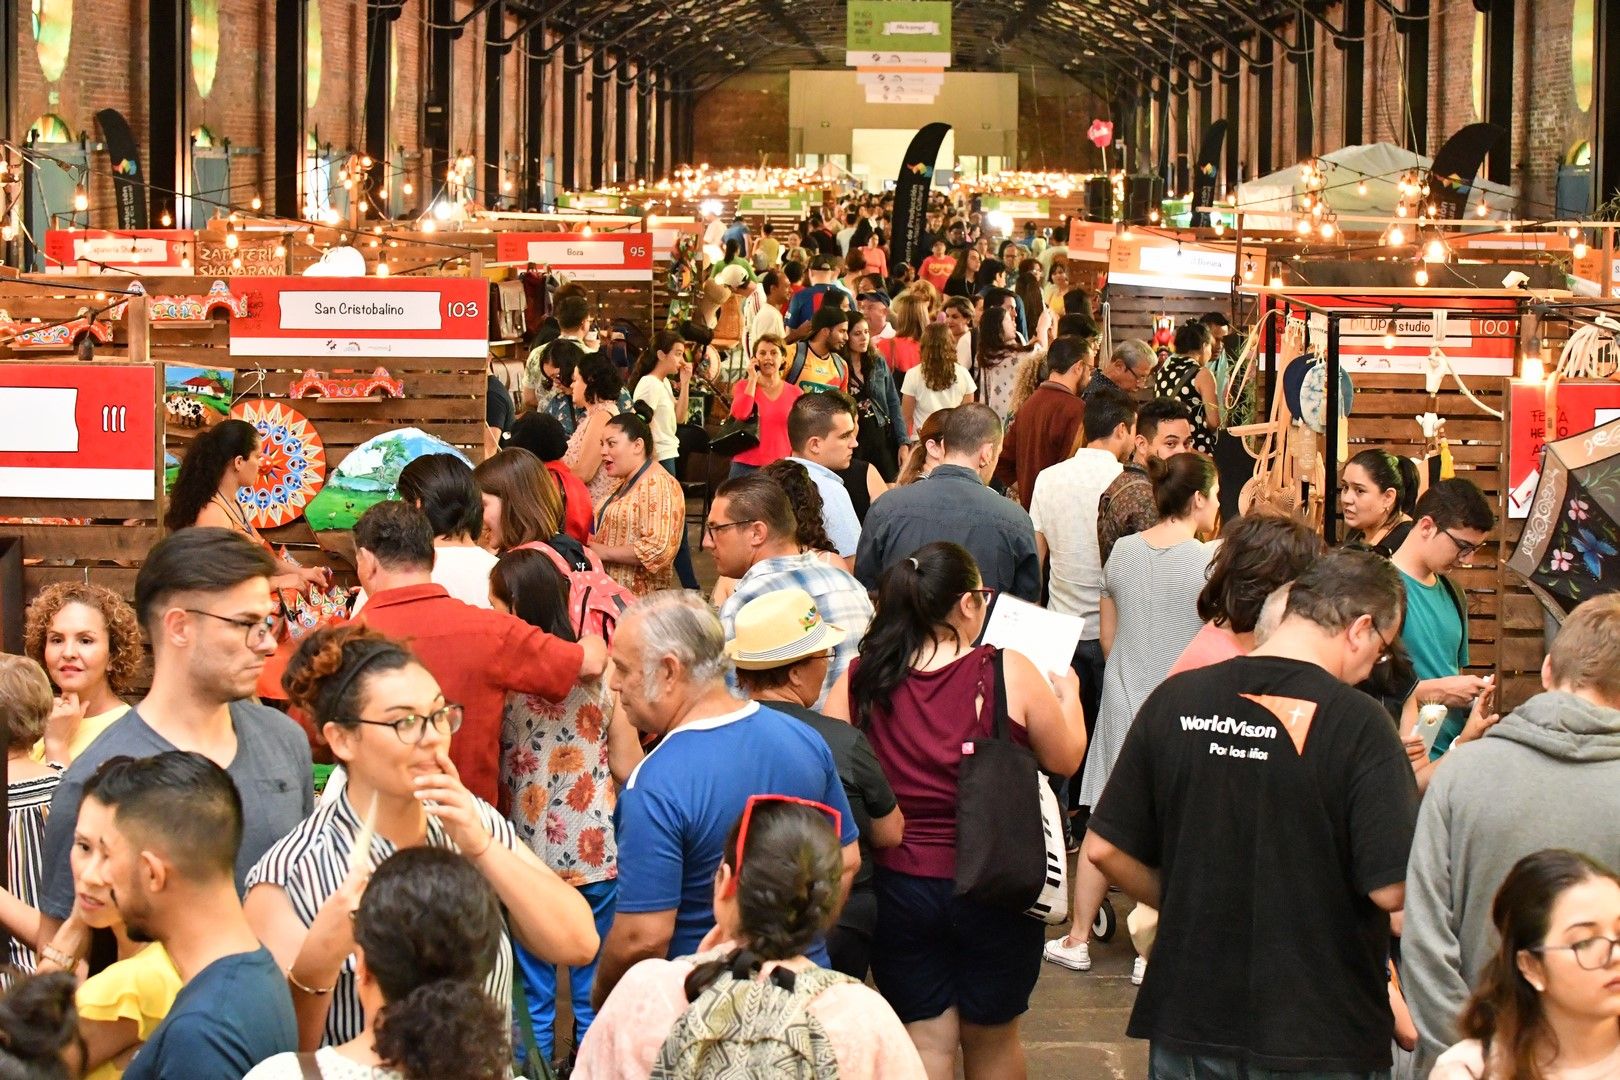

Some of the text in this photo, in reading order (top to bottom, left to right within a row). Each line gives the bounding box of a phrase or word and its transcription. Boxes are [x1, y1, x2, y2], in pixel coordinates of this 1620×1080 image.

[629, 246, 646, 258] 95
[314, 302, 404, 316] San Cristobalino
[447, 301, 479, 318] 103
[1393, 320, 1431, 333] studio
[1477, 319, 1510, 335] 100
[101, 404, 127, 432] 111
[1529, 426, 1569, 440] HEO
[1229, 745, 1247, 759] los
